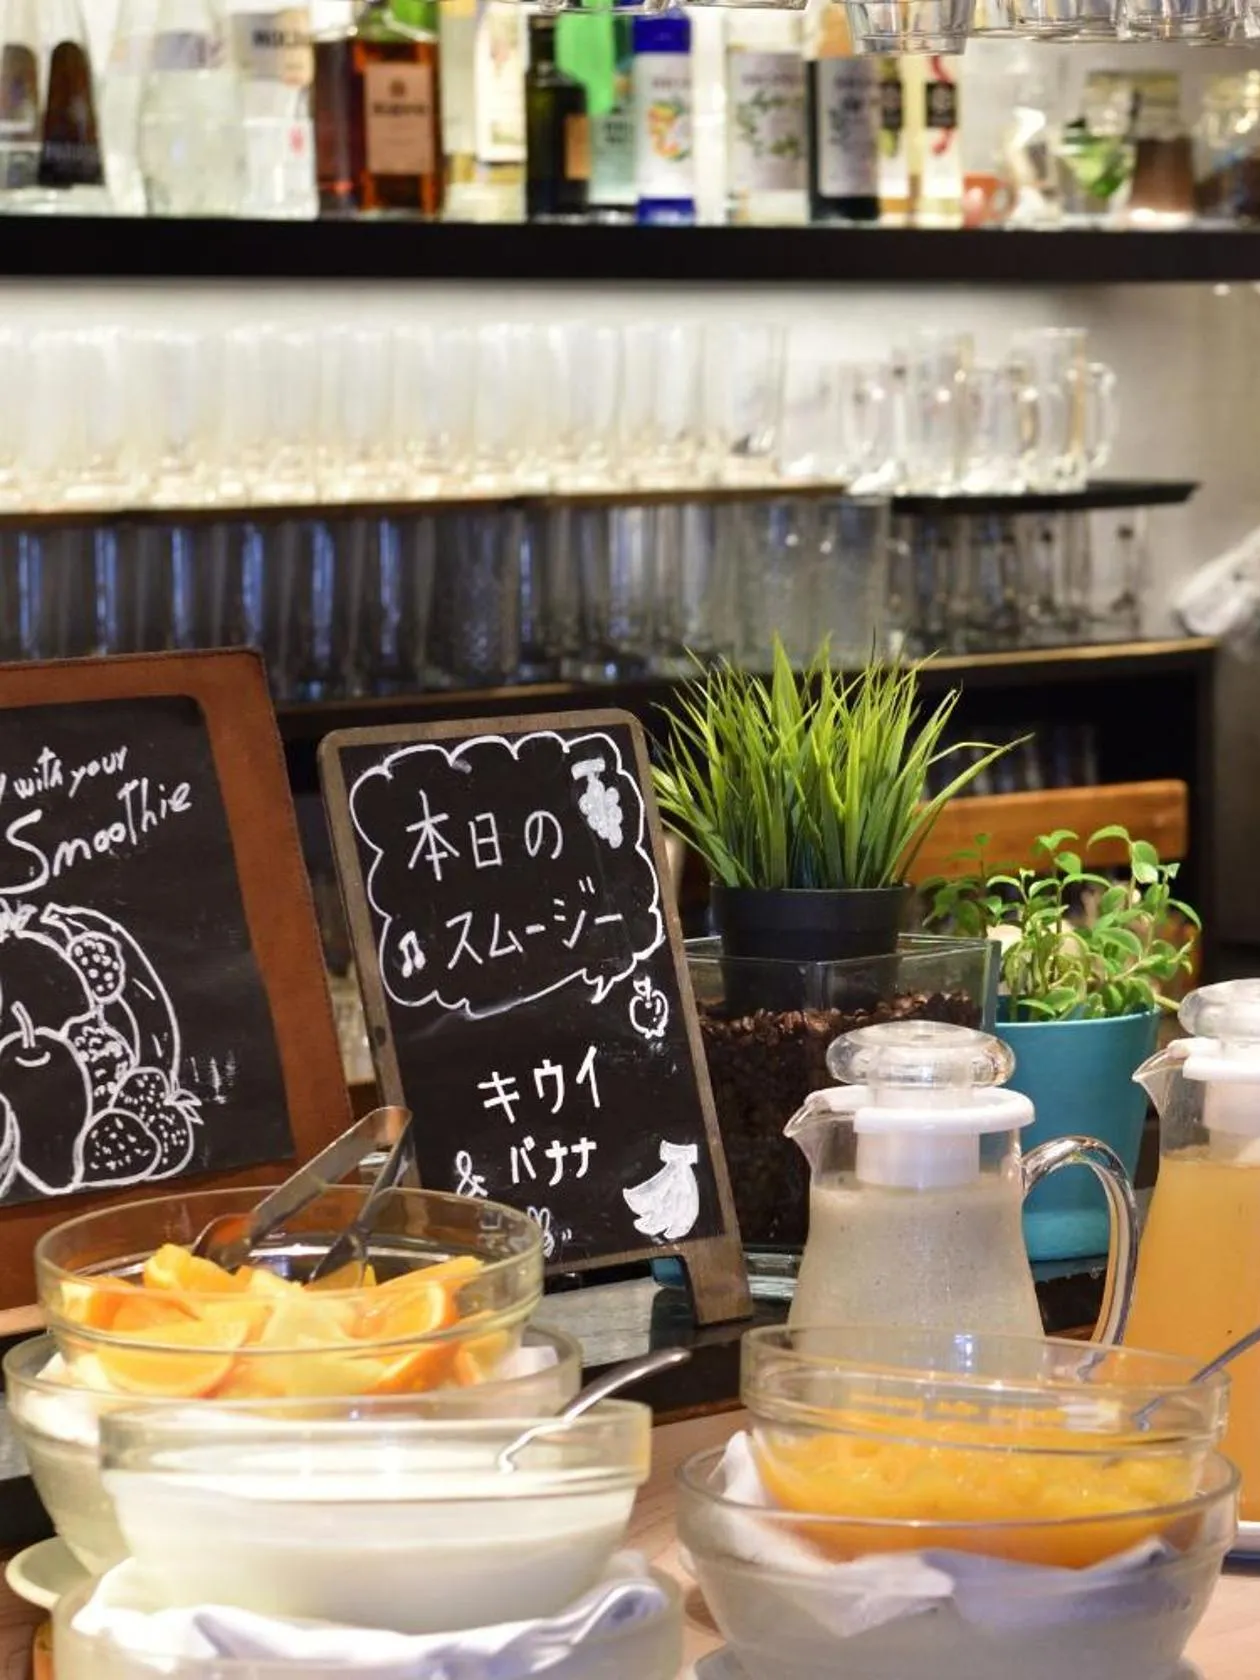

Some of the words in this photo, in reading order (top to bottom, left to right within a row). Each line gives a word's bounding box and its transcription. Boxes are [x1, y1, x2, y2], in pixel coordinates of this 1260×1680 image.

[68, 745, 128, 798] your
[406, 789, 563, 881] 本日の
[444, 876, 624, 971] スムージー
[477, 1044, 602, 1124] キウイ
[510, 1135, 597, 1187] バナナ
